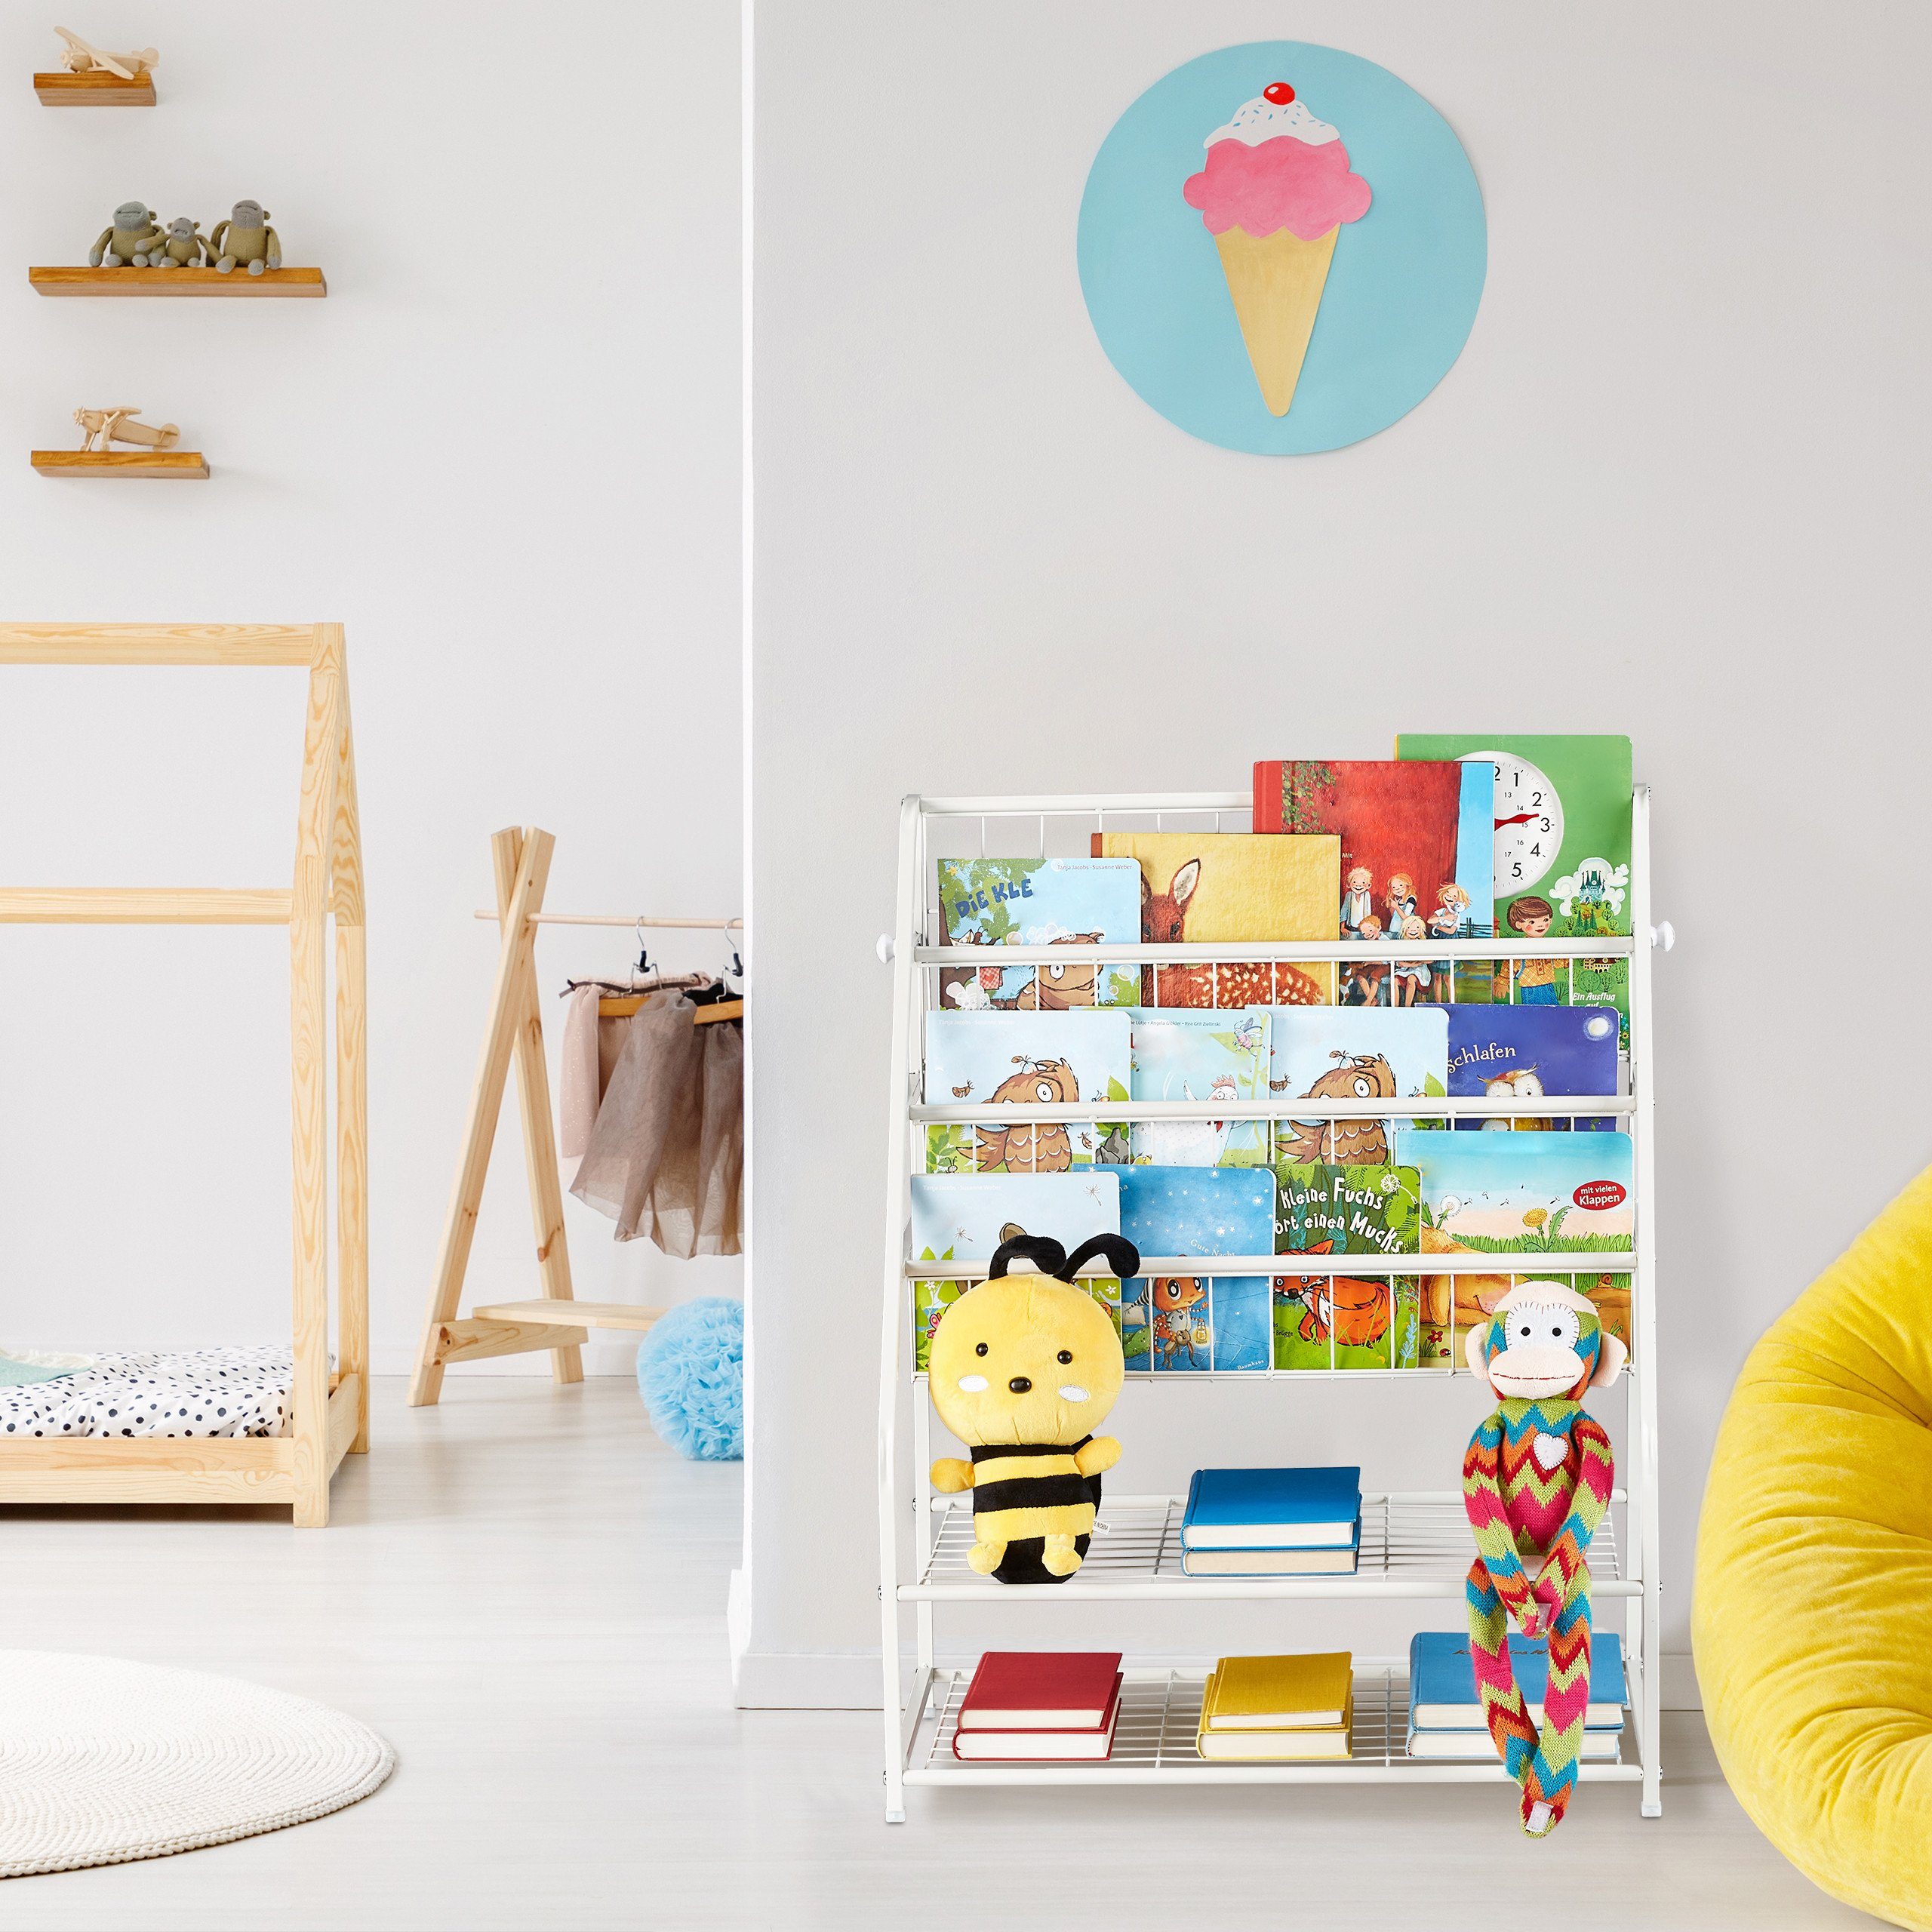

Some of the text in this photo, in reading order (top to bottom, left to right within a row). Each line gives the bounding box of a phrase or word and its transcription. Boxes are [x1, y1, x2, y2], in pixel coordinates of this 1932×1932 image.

[1513, 772, 1518, 787] 1
[1532, 792, 1542, 807] 2
[1540, 817, 1550, 832] 3
[1530, 842, 1541, 857] 4
[1512, 863, 1521, 878] 5
[1586, 992, 1616, 1002] Ausflug
[1333, 1177, 1383, 1210] Fuchs
[1580, 1185, 1617, 1195] mit vielen
[1579, 1195, 1620, 1207] Klappen
[1275, 1211, 1404, 1253] ört einen Mucks
